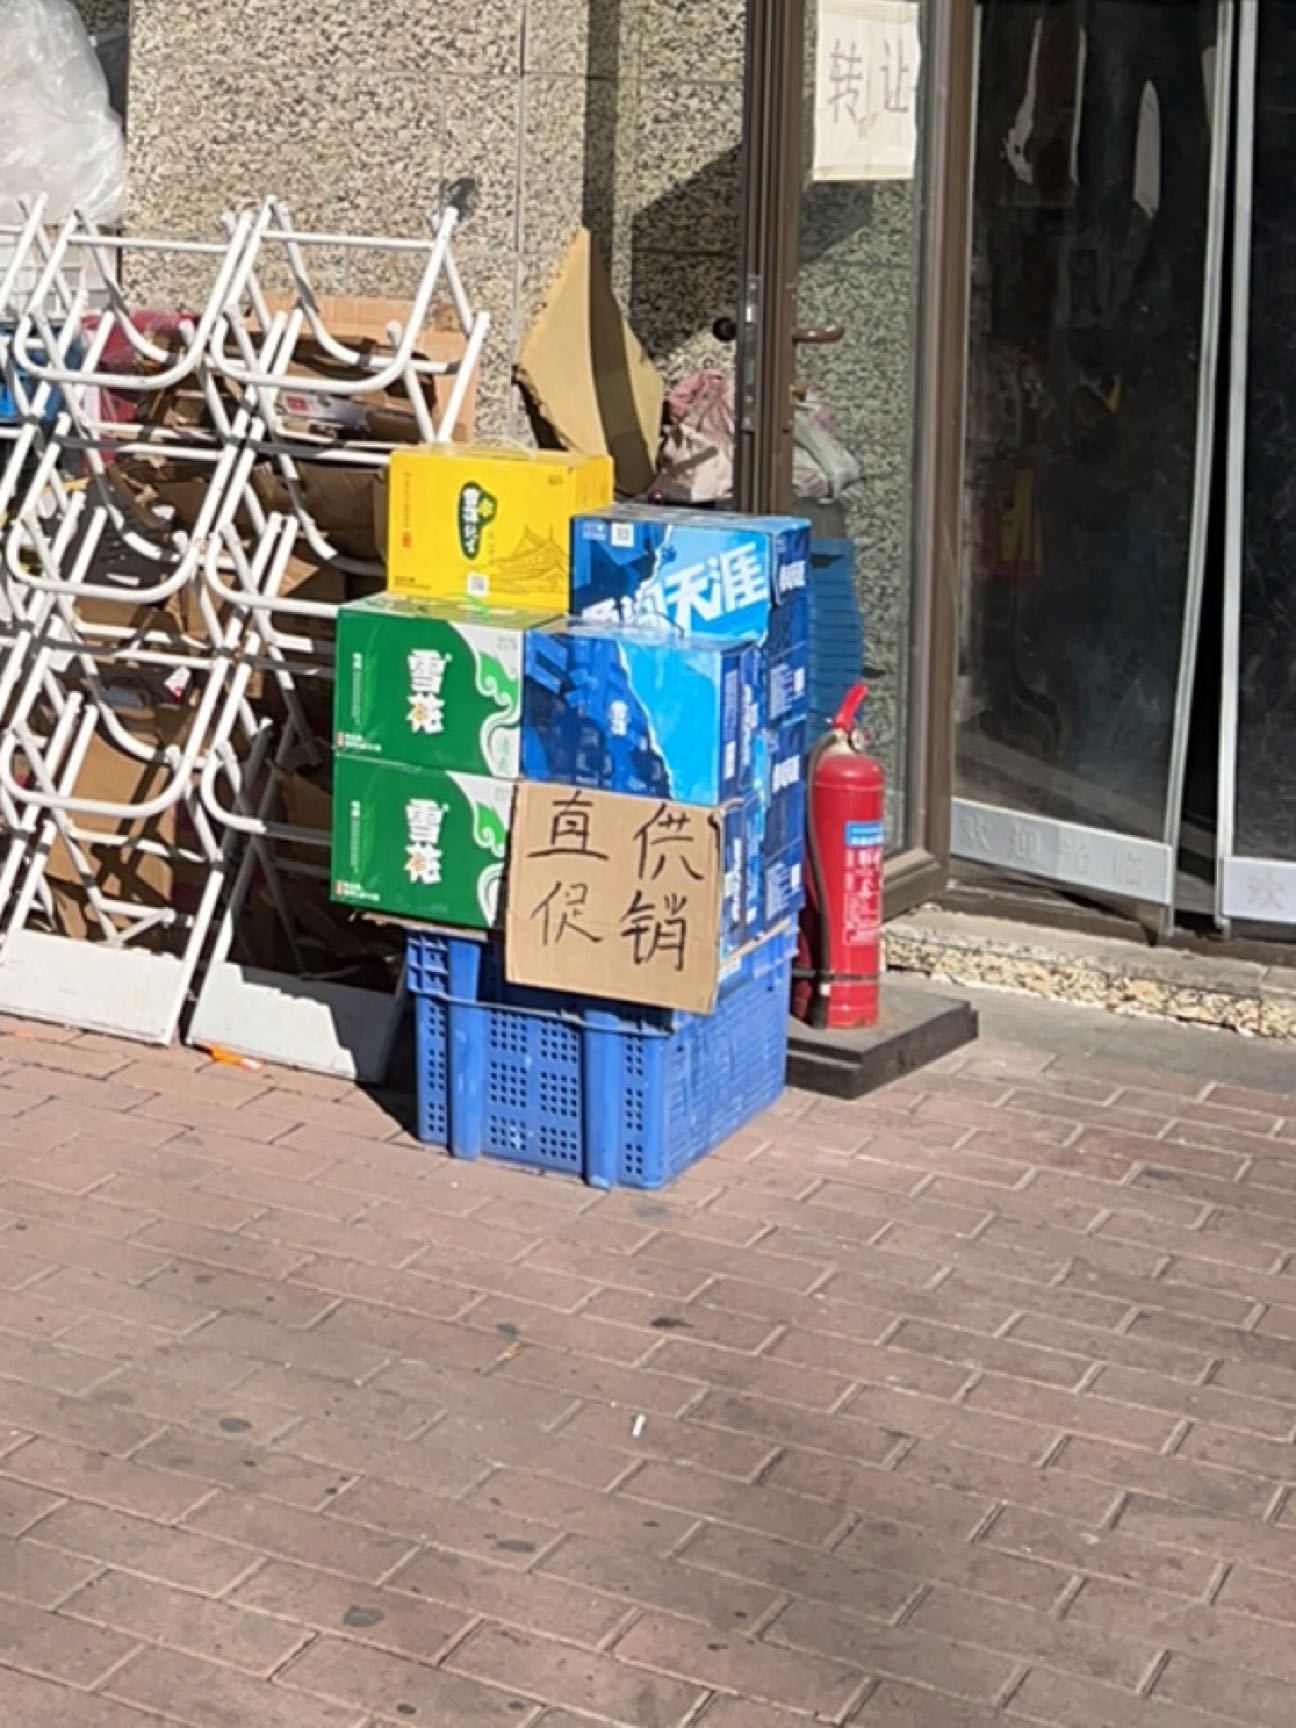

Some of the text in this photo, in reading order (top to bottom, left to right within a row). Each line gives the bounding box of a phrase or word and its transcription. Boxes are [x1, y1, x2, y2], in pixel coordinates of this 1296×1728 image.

[405, 648, 447, 735] 雪花
[403, 798, 445, 885] 雪花
[530, 880, 688, 972] 促销
